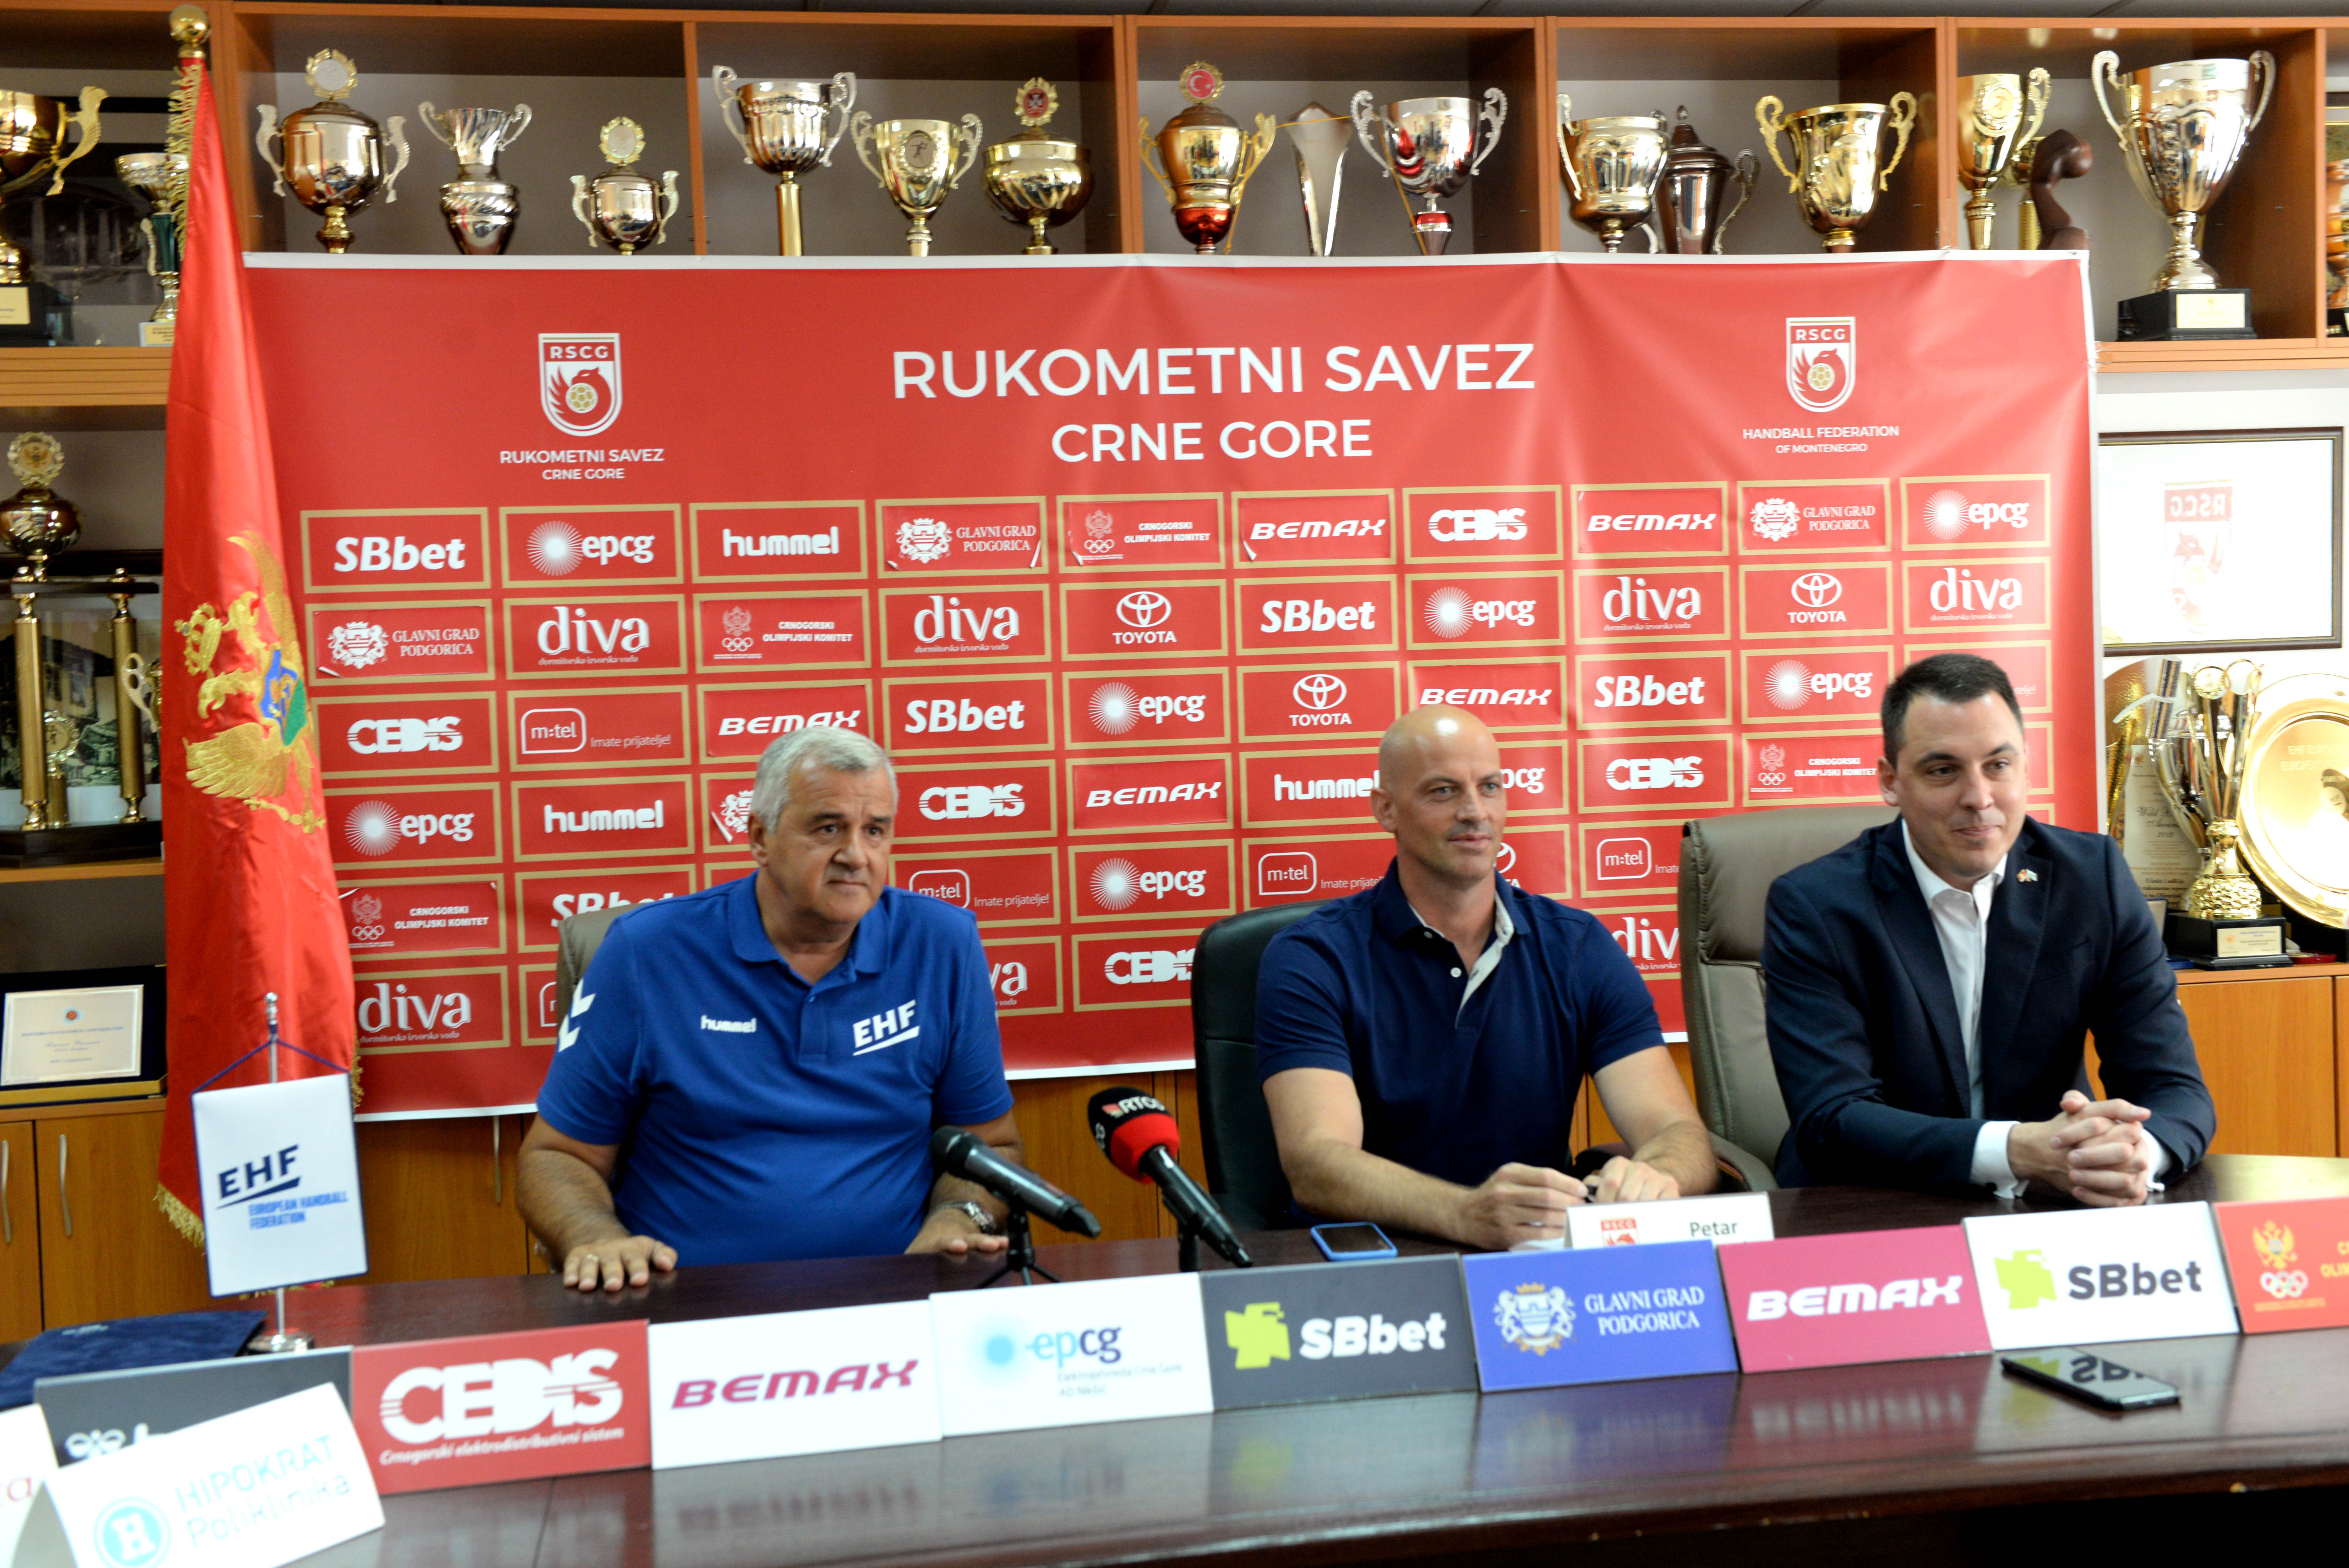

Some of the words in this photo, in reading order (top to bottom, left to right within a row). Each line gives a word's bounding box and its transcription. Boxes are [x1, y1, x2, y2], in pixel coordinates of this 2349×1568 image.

[1797, 329, 1845, 341] RSCG
[551, 346, 608, 359] RSCG
[894, 347, 1303, 399] RUKOMETNI
[1326, 344, 1535, 392] SAVEZ
[1052, 423, 1204, 463] CRNE
[1220, 420, 1372, 459] GORE
[1743, 428, 1814, 439] HANDBALL
[1818, 426, 1900, 438] FEDERATION
[501, 450, 605, 464] RUKOMETNI
[609, 449, 664, 462] SAVEZ
[1776, 445, 1791, 454] OF
[1793, 444, 1868, 453] MONTENEGRO
[543, 469, 582, 480] CRNE
[585, 469, 625, 479] GORE
[1429, 508, 1528, 542] CEDIS
[1588, 514, 1716, 532] BEMAX
[1804, 507, 1843, 518] GLAVNI
[1845, 506, 1876, 517] GRAD
[1968, 503, 2030, 530] epcg
[957, 526, 1001, 538] GLAVNI
[1003, 526, 1037, 537] GRAD
[1125, 534, 1173, 543] OLIMPIJSKI
[1174, 533, 1210, 542] KOMITET
[1139, 522, 1193, 531] CRNOGORSKI
[1251, 520, 1386, 540] BEMAX
[1810, 520, 1870, 531] PODGORICA
[335, 536, 465, 572] SBbet
[581, 536, 655, 566] epcg
[723, 526, 839, 557] hummel
[964, 540, 1031, 552] PODGORICA
[1602, 574, 1702, 623] diva
[1930, 566, 2023, 613] diva
[779, 622, 835, 630] CRNOGORSKI
[914, 595, 1020, 644] diva
[1261, 600, 1376, 633] SBbet
[1472, 600, 1536, 629] epcg
[1788, 611, 1847, 624] TOYOTA
[393, 630, 445, 643] GLAVNI
[445, 628, 480, 641] GRAD
[538, 606, 650, 656] diva
[763, 634, 813, 642] OLIMPIJSKI
[1113, 631, 1177, 645] TOYOTA
[401, 644, 473, 657] PODGORICA
[1420, 689, 1552, 705] BEMAX
[1594, 675, 1706, 708] SBbet
[1811, 672, 1873, 700] epcg
[718, 710, 861, 736] BEMAX
[905, 699, 1025, 734] SBbet
[1139, 695, 1207, 725] epcg
[1289, 713, 1352, 727] TOYOTA
[348, 716, 463, 754] CEDIS
[531, 722, 577, 739] m:tel
[591, 737, 622, 747] Imate
[623, 734, 671, 748] prijatelje!
[1606, 756, 1704, 791] CEDIS
[1809, 758, 1861, 766] CRNOGORSKI
[1500, 768, 1545, 794] pcg
[920, 784, 1025, 821] CEDIS
[1087, 782, 1222, 807] BEMAX
[401, 813, 475, 843] epcg
[545, 800, 664, 833] hummel
[1606, 850, 1644, 866] m:tel
[1139, 870, 1207, 900] epcg
[1268, 865, 1308, 881] m:tel
[1321, 879, 1348, 889] Imate
[410, 906, 469, 917] CRNOGORSKI
[975, 897, 1003, 907] Imate
[1005, 893, 1050, 907] prijatelje!
[395, 919, 447, 930] OLIMPIJSKI
[448, 917, 489, 927] KOMITET
[1612, 917, 1680, 960] div
[359, 983, 472, 1033] diva
[440, 1031, 460, 1039] voda
[701, 1015, 756, 1033] hummel
[853, 1000, 916, 1048] EHF
[218, 1144, 299, 1199] EHF
[1690, 1221, 1738, 1237] Petar
[2069, 1262, 2201, 1300] SBbet
[1584, 1290, 1652, 1315] GLAVNI
[1653, 1286, 1705, 1308] GRAD
[1748, 1276, 1963, 1321] BEMAX
[1598, 1310, 1700, 1336] PODGORICA
[1031, 1326, 1122, 1369] epcg
[1300, 1313, 1446, 1360] SBbet
[380, 1347, 624, 1443] CEDIS
[673, 1361, 918, 1409] BEMAX
[175, 1434, 333, 1512] HIPOKRAT
